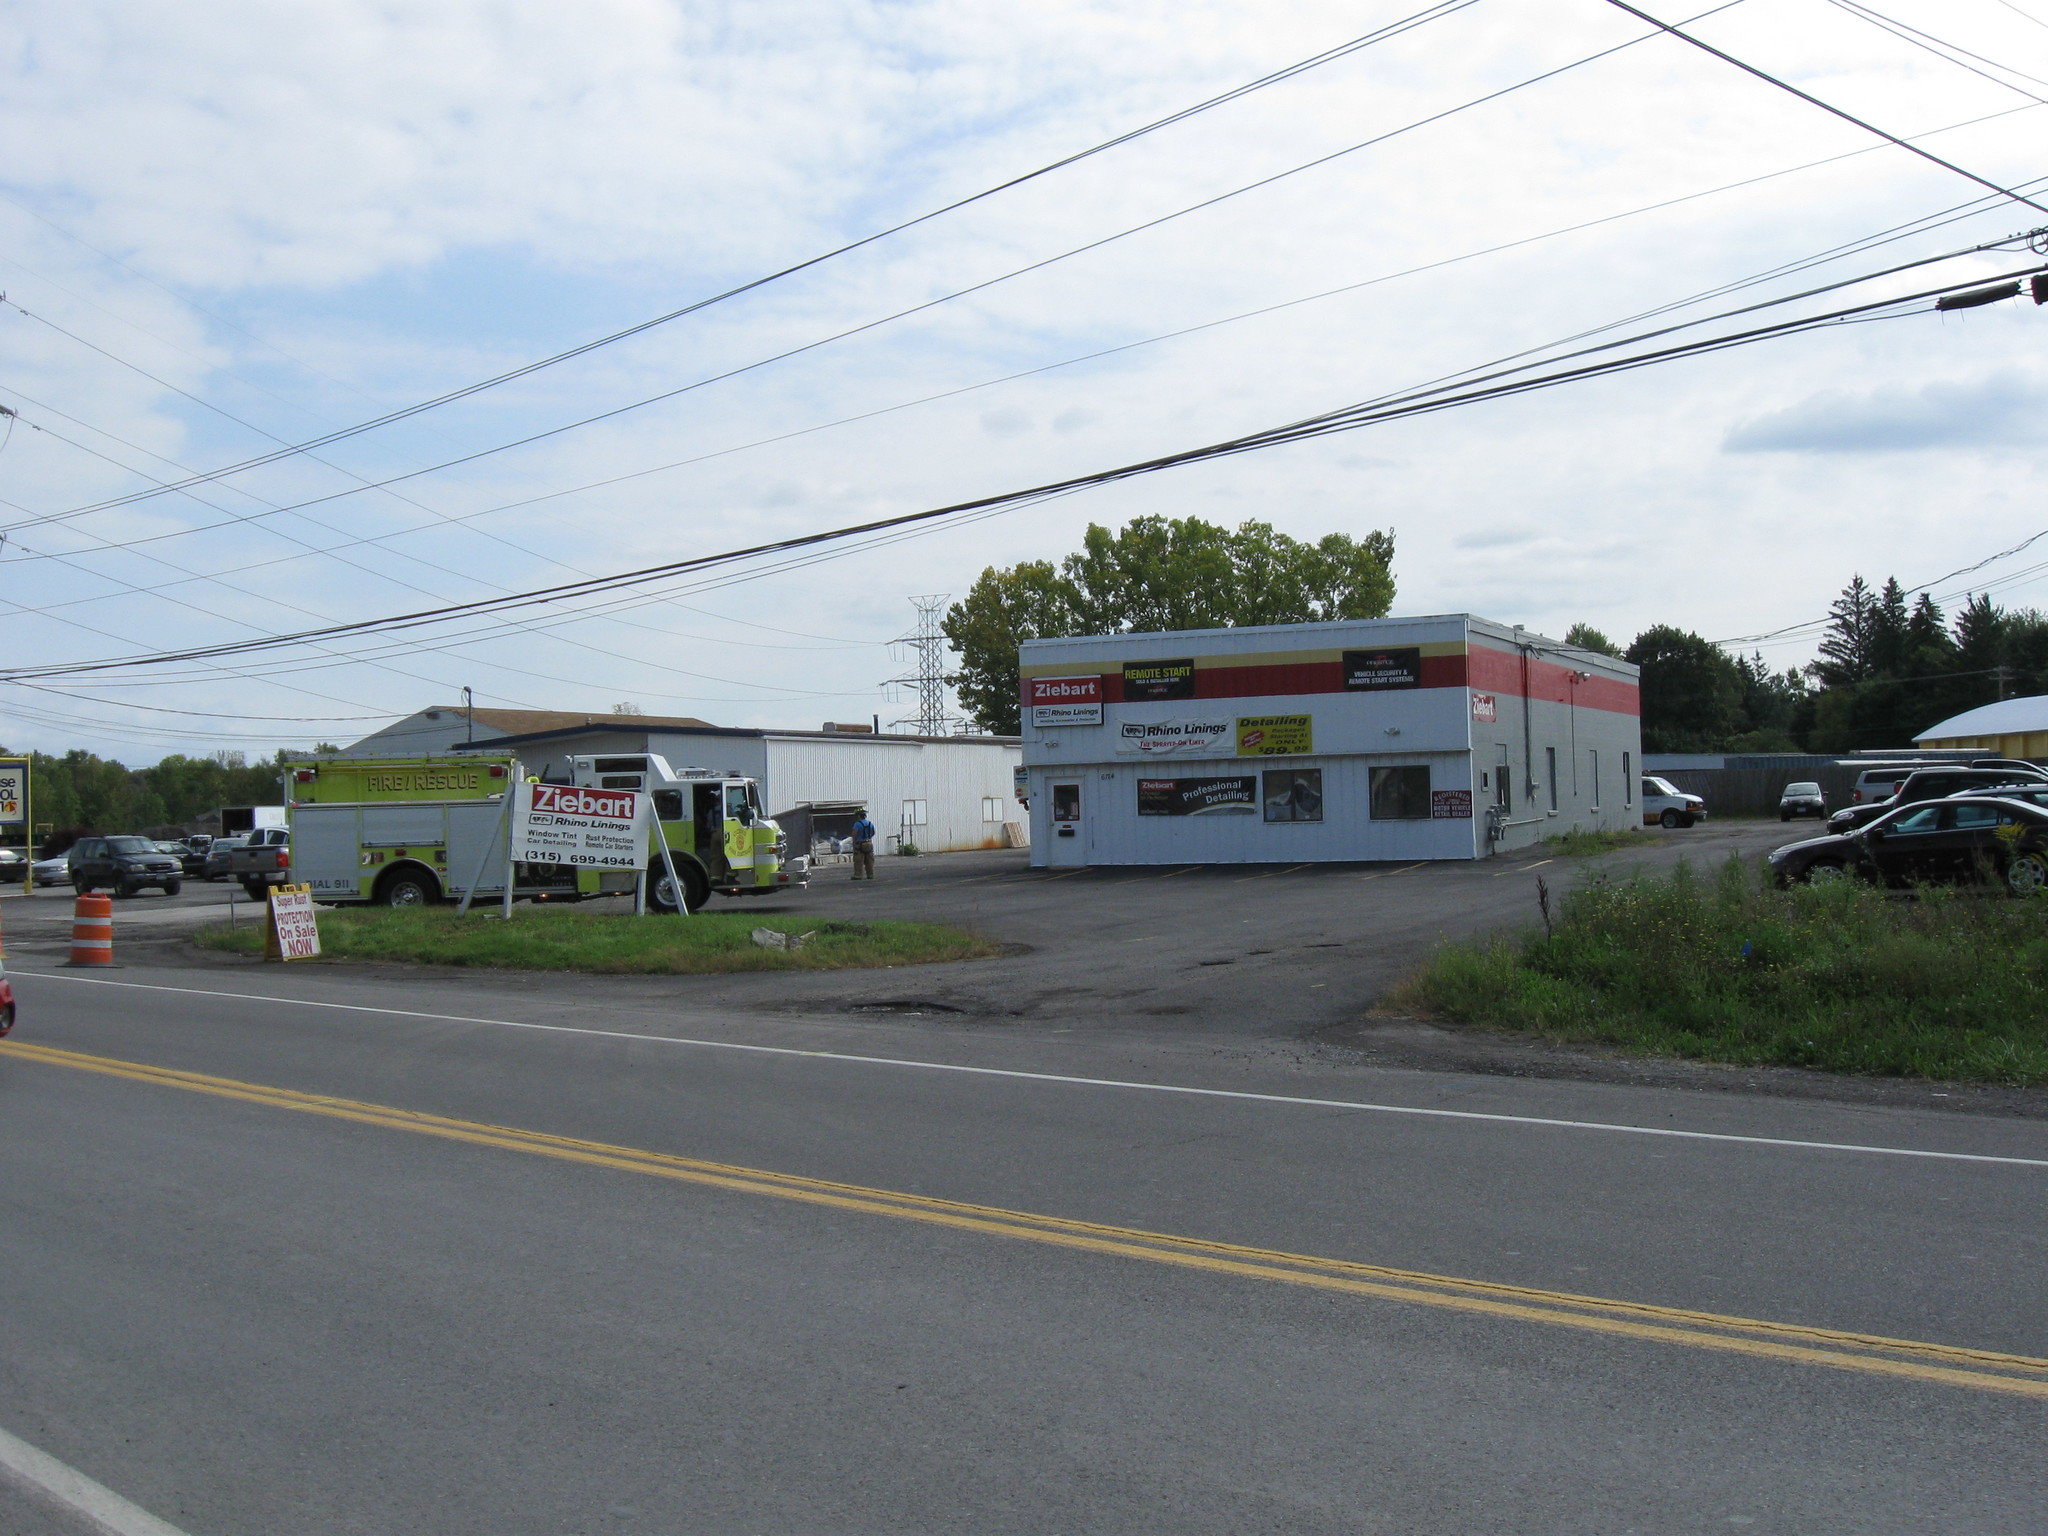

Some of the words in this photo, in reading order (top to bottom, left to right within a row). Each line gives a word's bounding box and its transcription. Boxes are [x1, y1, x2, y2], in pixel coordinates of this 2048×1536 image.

[1125, 669, 1160, 679] REMOTE
[1163, 666, 1191, 677] START
[1035, 682, 1095, 697] Ziebart
[1073, 707, 1099, 717] Linings
[1240, 716, 1308, 727] Detailing
[1147, 725, 1181, 736] Rhino
[1185, 723, 1227, 735] Linings
[415, 774, 478, 790] RESCUE
[1142, 781, 1174, 789] Ziebart
[1182, 780, 1242, 802] Professional
[1206, 791, 1249, 804] Detailing
[533, 787, 633, 817] Ziebart
[555, 817, 588, 827] Rhino
[590, 820, 631, 831] Linings
[528, 829, 559, 838] Window
[562, 832, 577, 840] Tint
[585, 833, 600, 842] Rust
[602, 835, 634, 844] Protection
[543, 838, 577, 848] Detailing
[525, 850, 561, 863] (315)
[570, 854, 635, 866] 699-4944
[335, 880, 349, 889] 911
[276, 894, 293, 908] Super
[294, 894, 307, 905] Rust
[277, 910, 314, 925] PROTECTION
[280, 926, 293, 939] On
[295, 924, 316, 938] Sale
[288, 938, 313, 956] NOW
